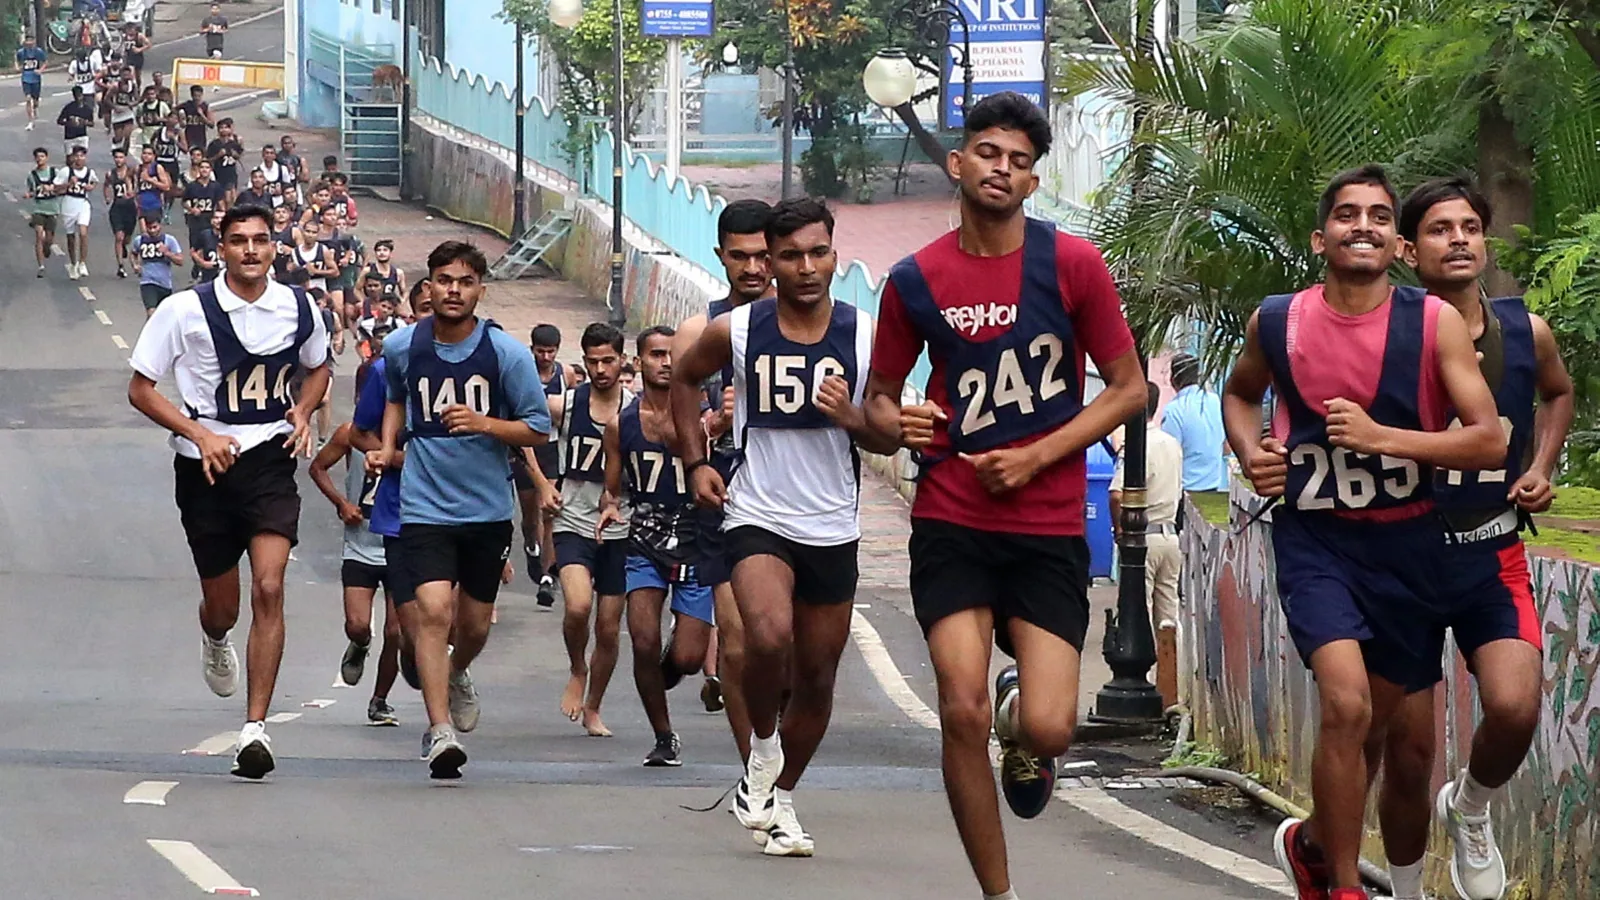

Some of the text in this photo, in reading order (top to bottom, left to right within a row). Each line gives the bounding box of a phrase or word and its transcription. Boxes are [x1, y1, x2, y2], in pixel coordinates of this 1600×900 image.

[951, 24, 977, 32] GRUP
[989, 23, 1041, 31] INSTITUTIONS
[956, 0, 1040, 22] NRI
[972, 46, 1024, 54] B.PHARMA
[418, 374, 490, 422] 140
[957, 333, 1067, 436] 242
[570, 436, 605, 472] 17
[630, 450, 686, 495] 171
[1291, 443, 1420, 510] 265
